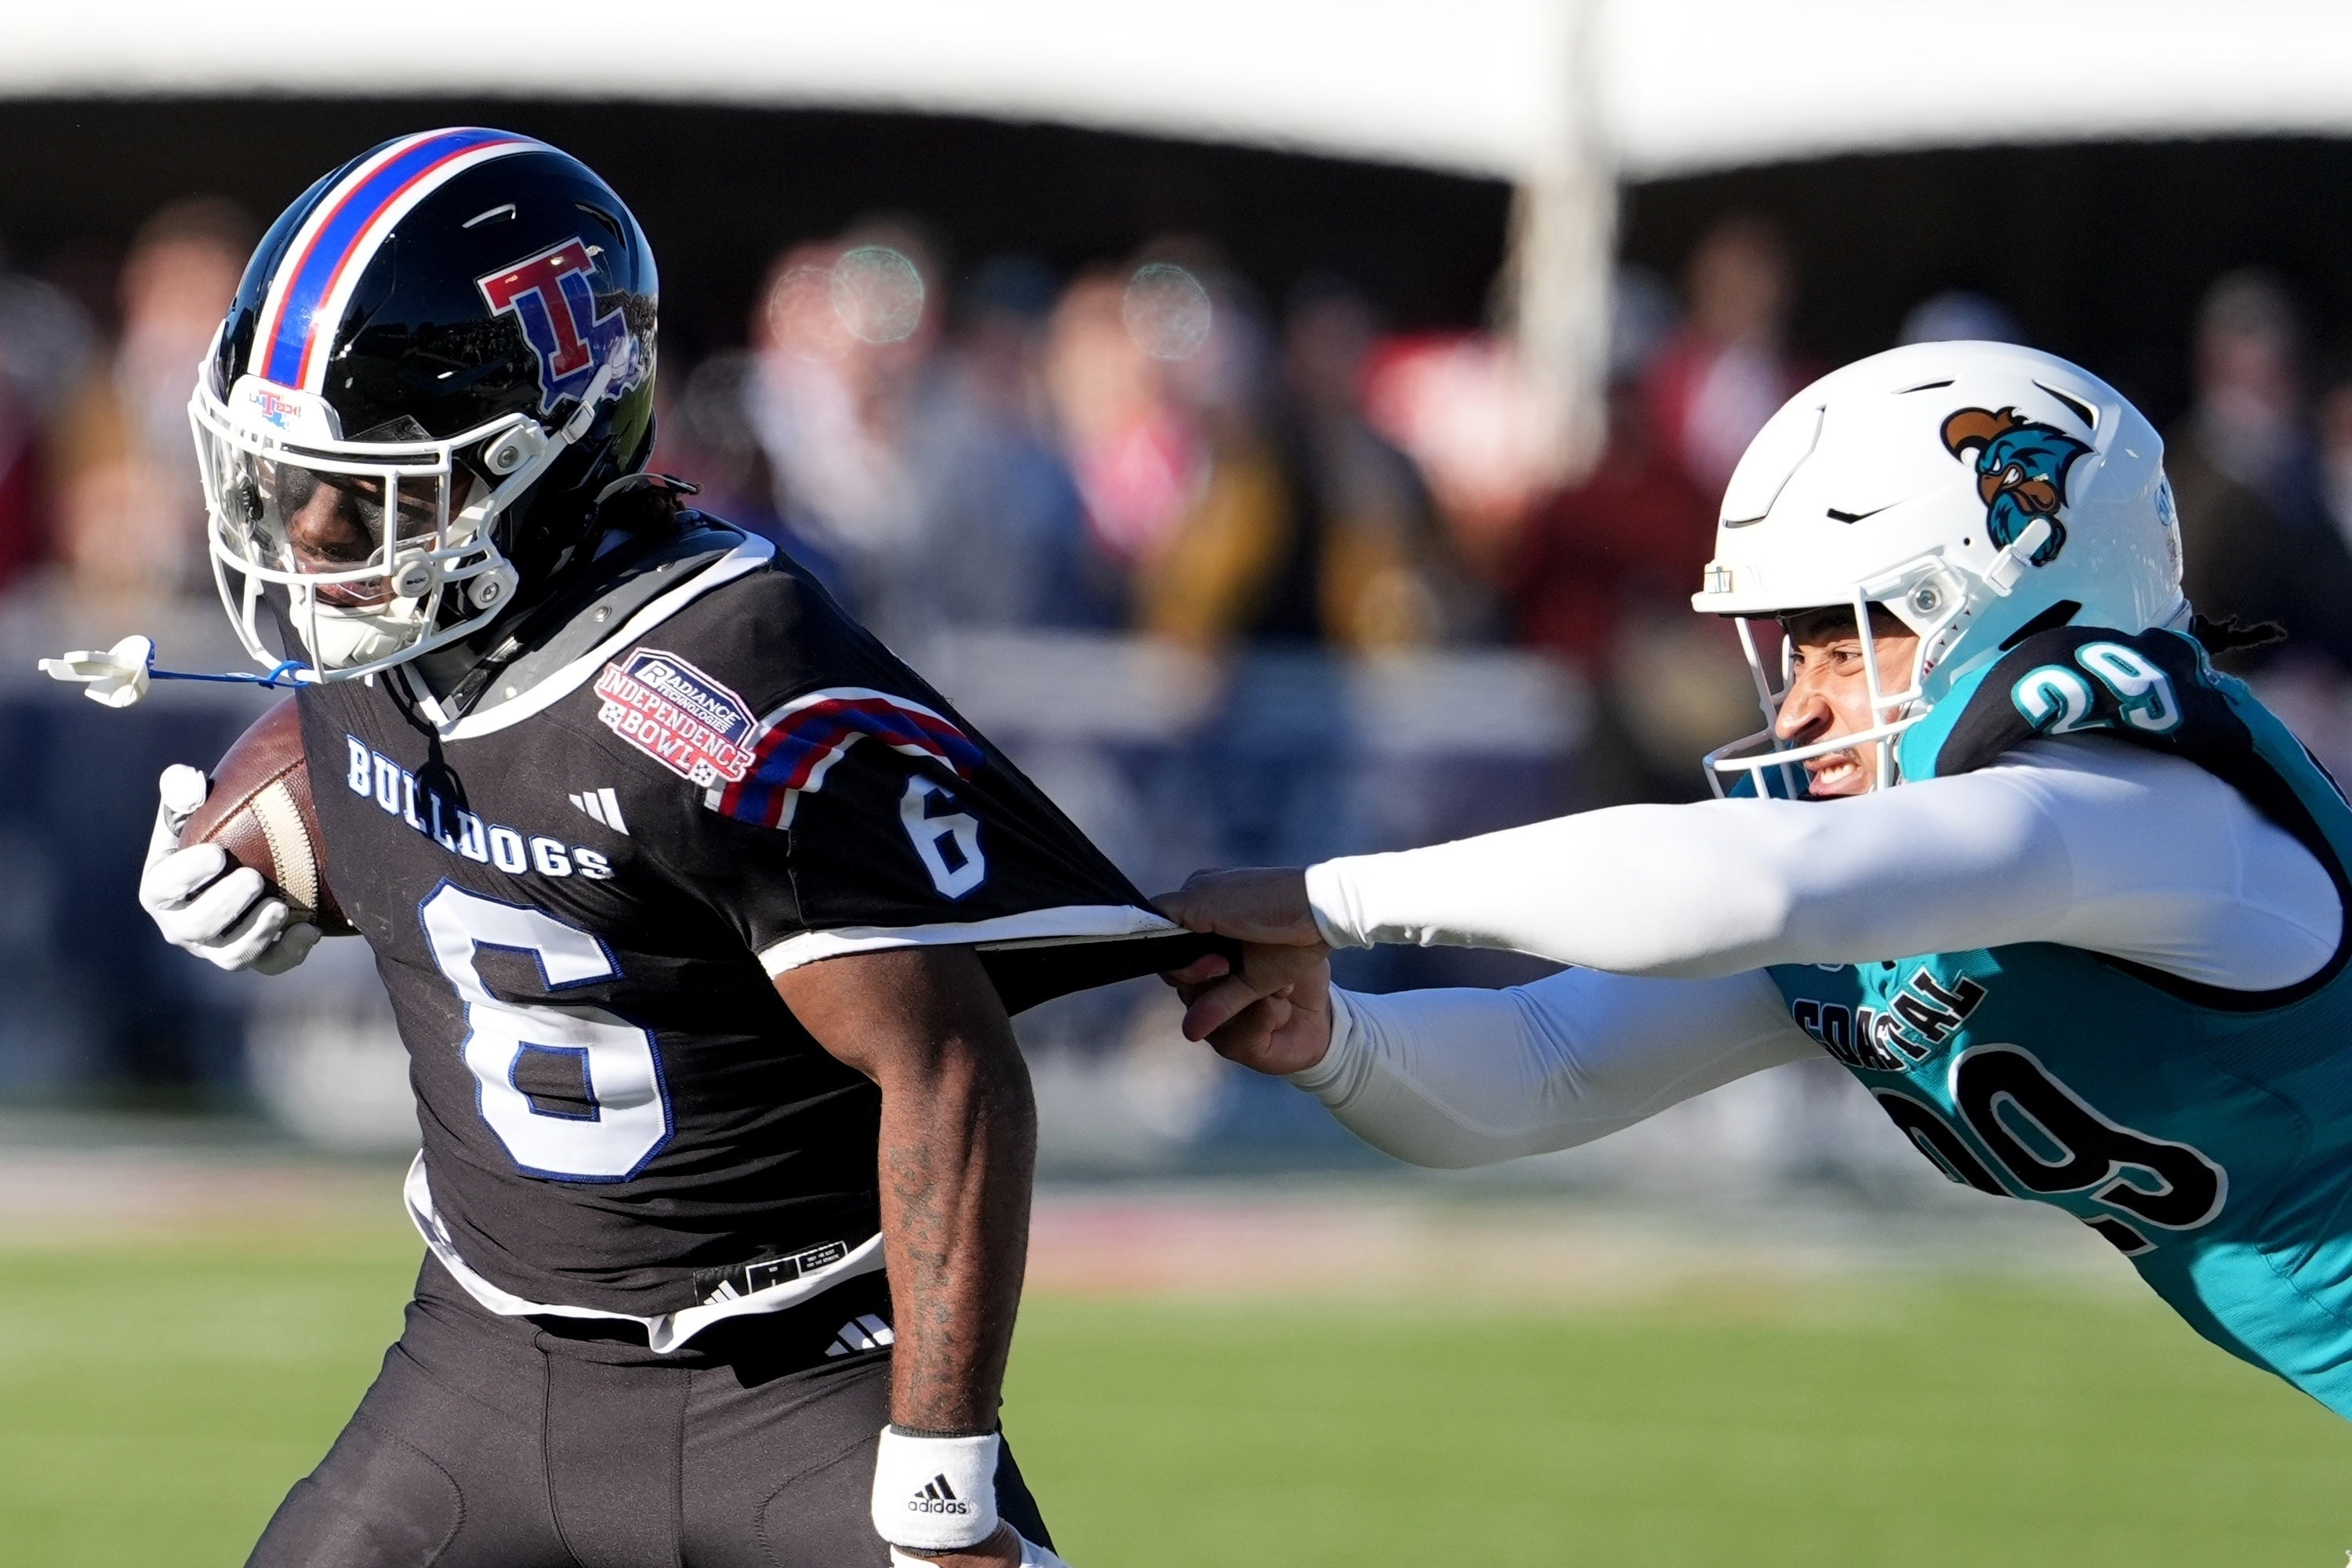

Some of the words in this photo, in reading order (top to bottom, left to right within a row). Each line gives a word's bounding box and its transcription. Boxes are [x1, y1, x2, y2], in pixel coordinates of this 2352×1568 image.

[599, 669, 748, 773] INDEPENDENCE
[635, 660, 741, 725] RADIANCE
[658, 684, 731, 734] TECHNOLOGIES
[2011, 641, 2183, 735] 29
[621, 710, 694, 770] BOWL
[347, 734, 615, 880] BULLDOGS
[898, 772, 985, 902] 6
[418, 877, 677, 1184] 6
[908, 1500, 967, 1514] adidas
